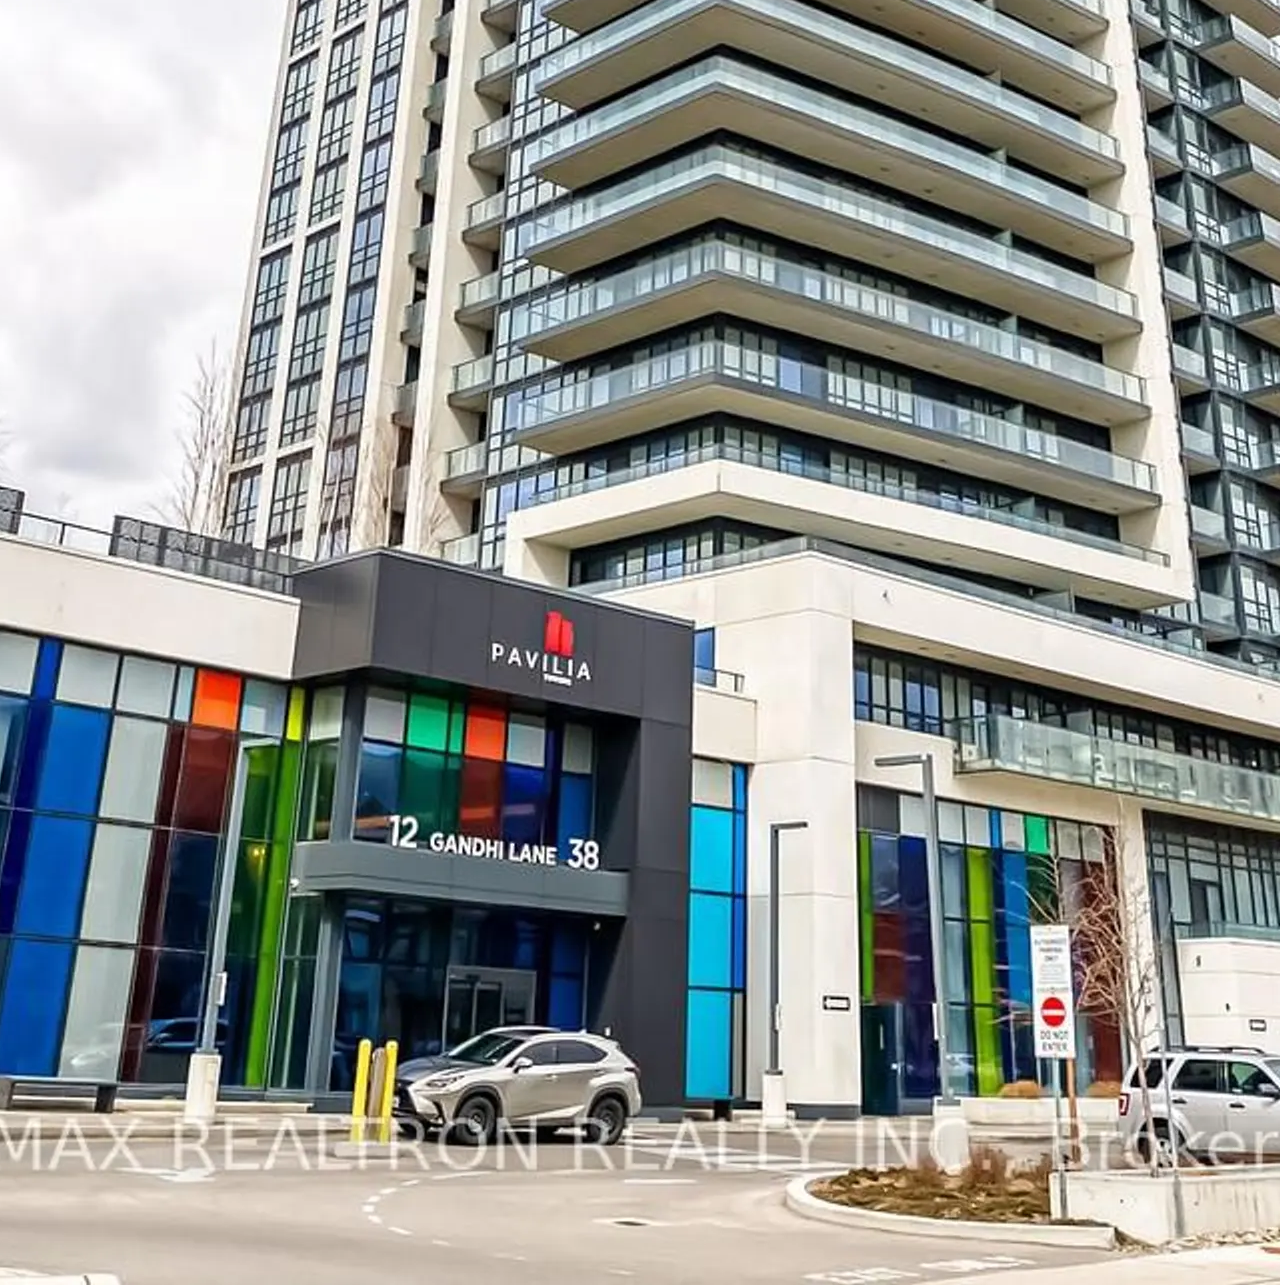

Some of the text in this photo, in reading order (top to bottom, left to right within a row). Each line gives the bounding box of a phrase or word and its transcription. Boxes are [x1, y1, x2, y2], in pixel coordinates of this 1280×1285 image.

[491, 642, 592, 681] PAVILIA
[388, 814, 600, 870] 12 GANDHI LANE 38
[1040, 1030, 1068, 1040] DO NOT
